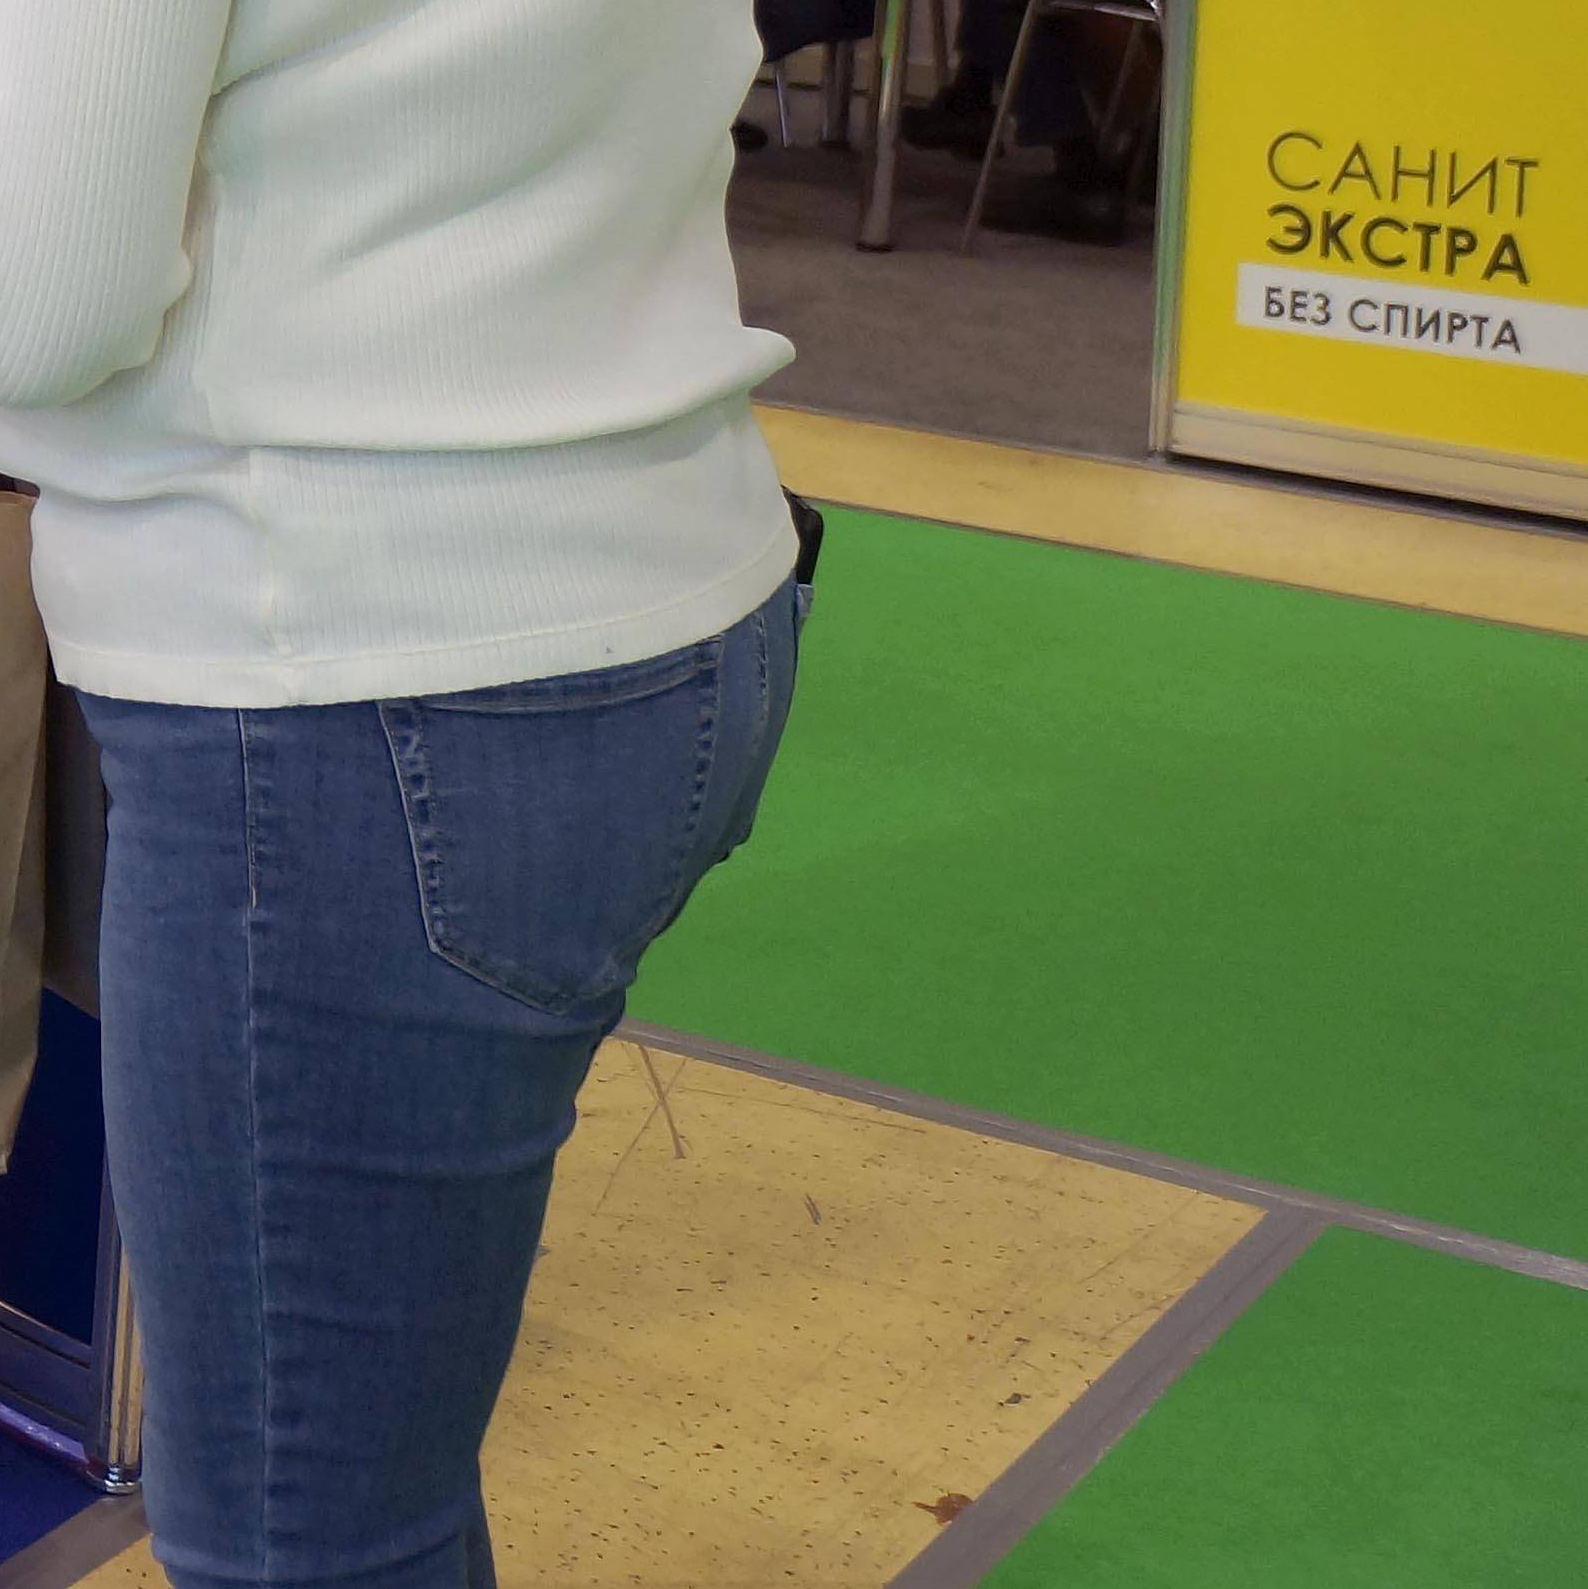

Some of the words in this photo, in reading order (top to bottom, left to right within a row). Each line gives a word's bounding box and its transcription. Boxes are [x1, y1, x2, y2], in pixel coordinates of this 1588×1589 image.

[1266, 130, 1540, 219] САНИТ
[1265, 202, 1531, 287] ЭКСТРА
[1262, 285, 1332, 327] БЕЗ
[1347, 298, 1523, 355] СПИРТА
